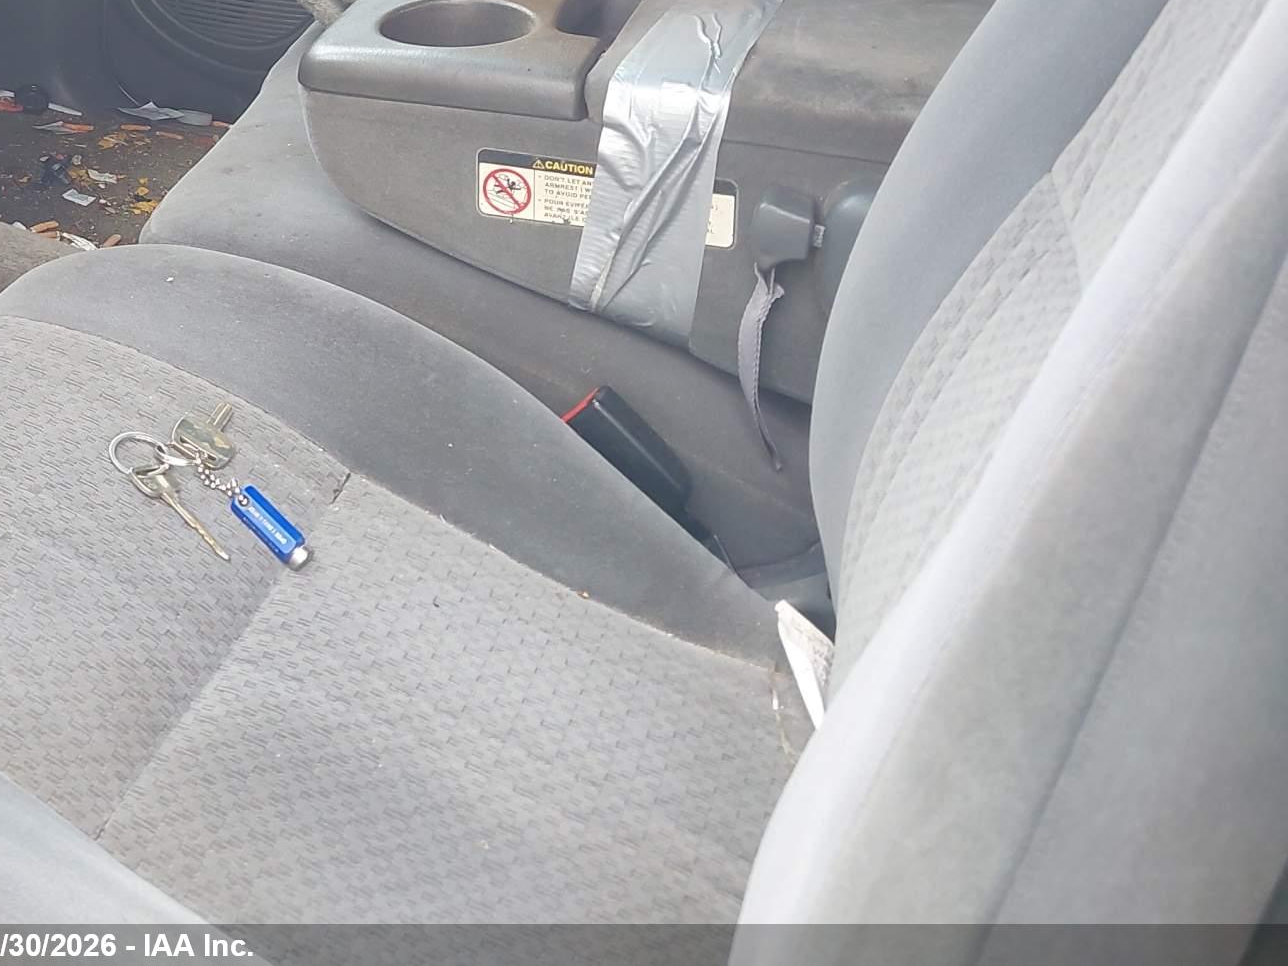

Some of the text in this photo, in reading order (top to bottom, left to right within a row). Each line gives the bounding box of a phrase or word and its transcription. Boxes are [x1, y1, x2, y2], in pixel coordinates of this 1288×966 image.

[545, 161, 592, 175] CAUTION
[544, 174, 565, 182] DON'T
[544, 182, 578, 190] ARMREST
[556, 190, 578, 198] AVOID
